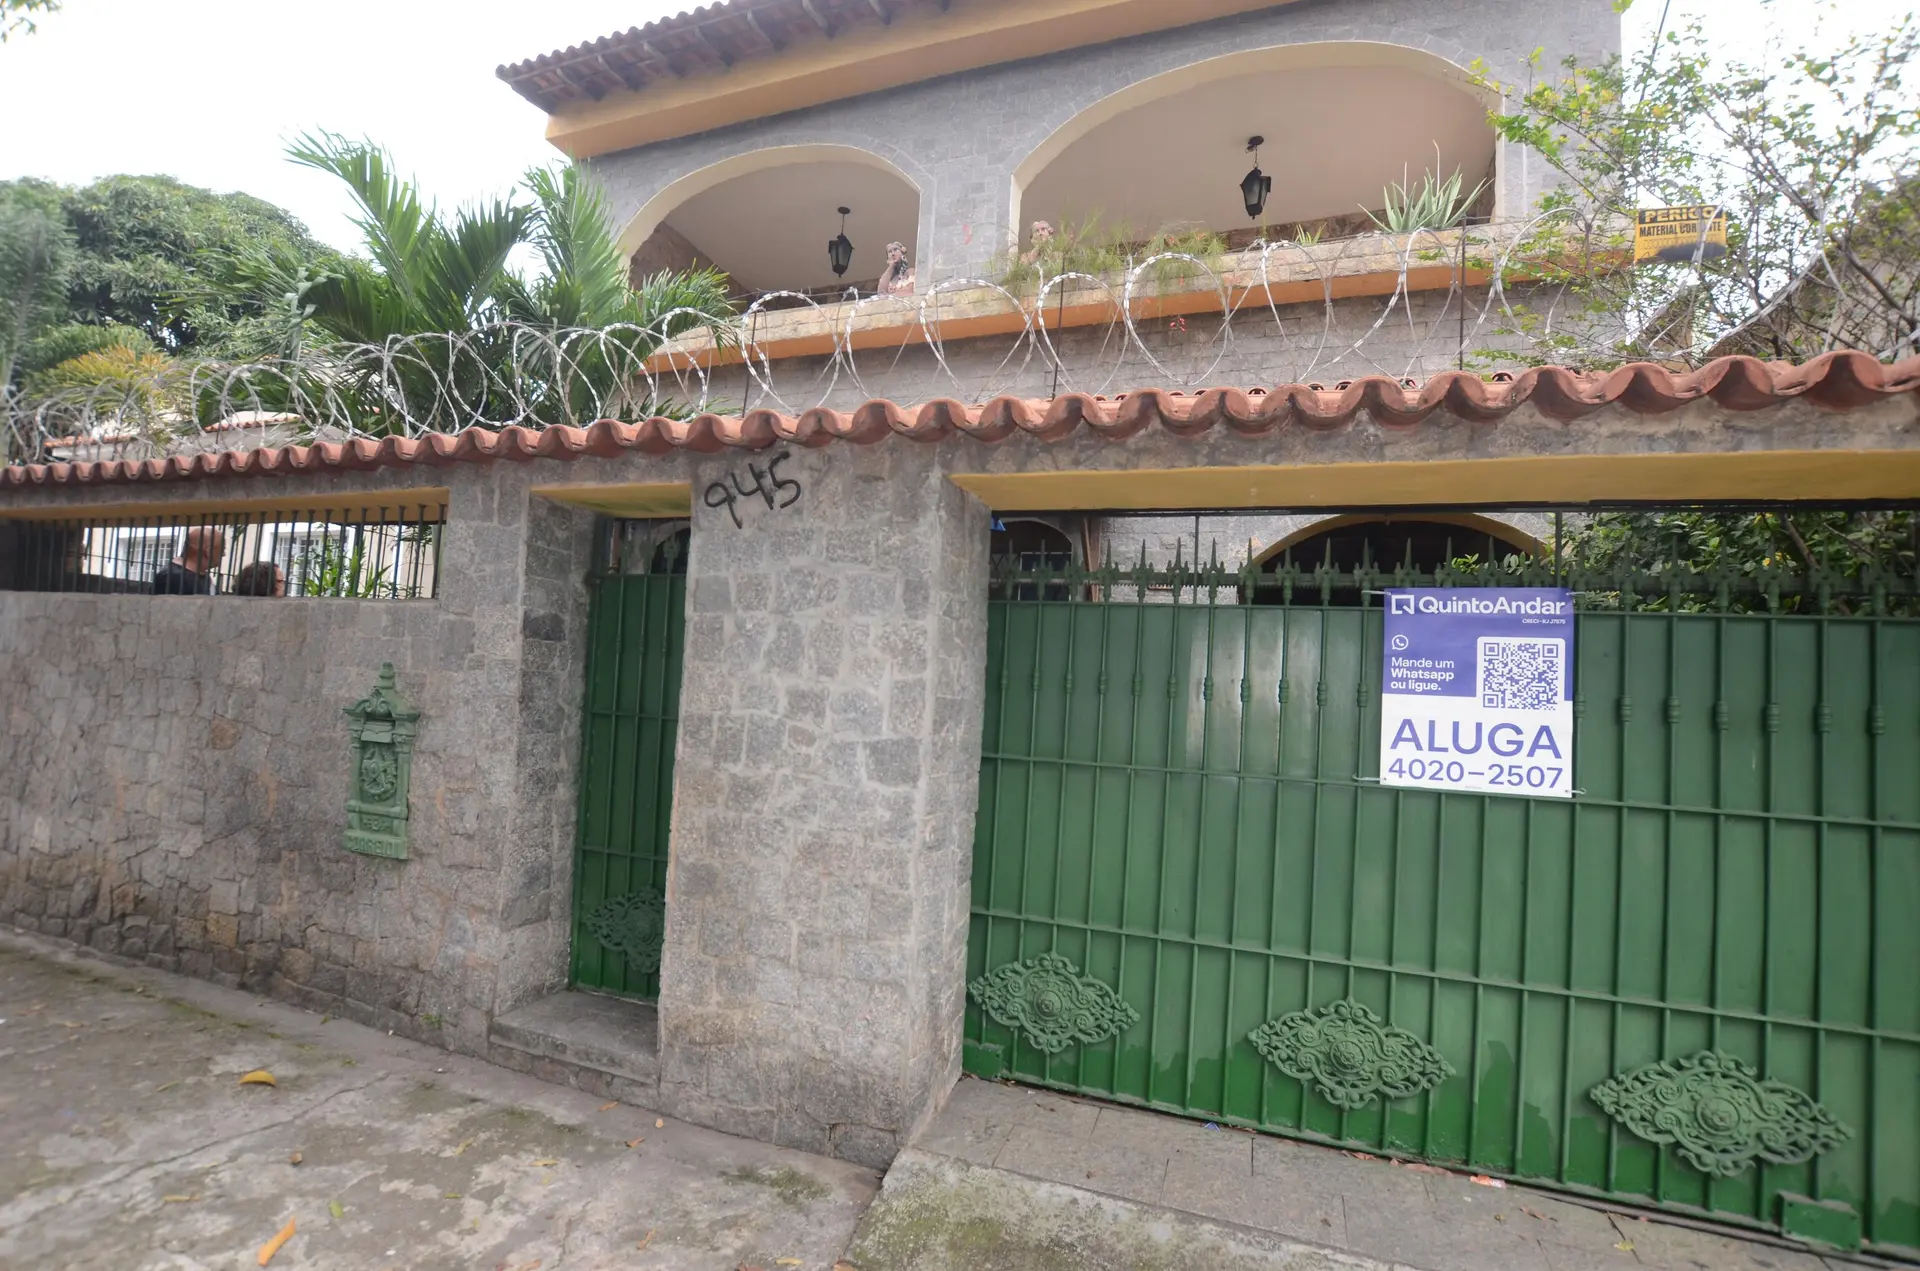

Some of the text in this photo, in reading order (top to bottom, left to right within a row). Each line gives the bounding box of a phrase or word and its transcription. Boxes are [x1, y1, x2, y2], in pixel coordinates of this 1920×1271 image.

[1639, 225, 1678, 237] MATERIAL
[704, 451, 801, 529] 945
[1418, 596, 1565, 615] QuintoAndar
[1391, 657, 1455, 669] Mande um
[1391, 668, 1455, 680] Whatsapp
[1390, 680, 1442, 691] ou ligue.
[1390, 718, 1562, 759] ALUGA
[1388, 758, 1563, 789] 4020-2507
